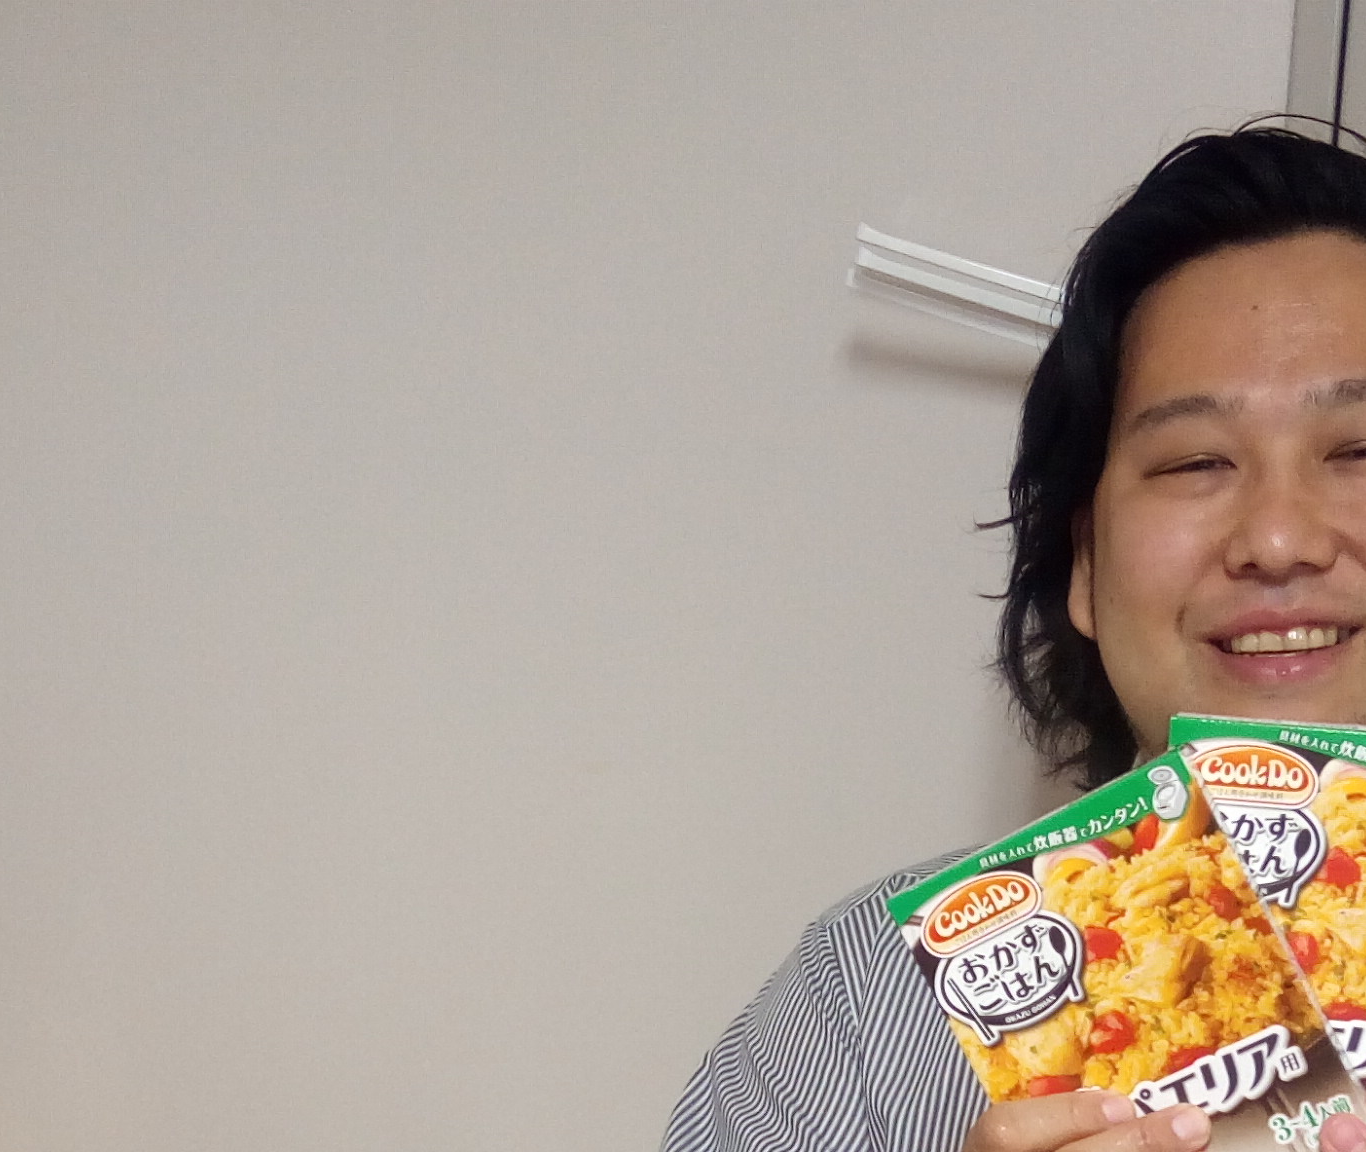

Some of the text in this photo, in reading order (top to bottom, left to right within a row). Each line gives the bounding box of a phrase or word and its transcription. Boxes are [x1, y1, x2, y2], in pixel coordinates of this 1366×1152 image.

[957, 922, 1046, 985] おかず
[973, 954, 1060, 1012] ごはん
